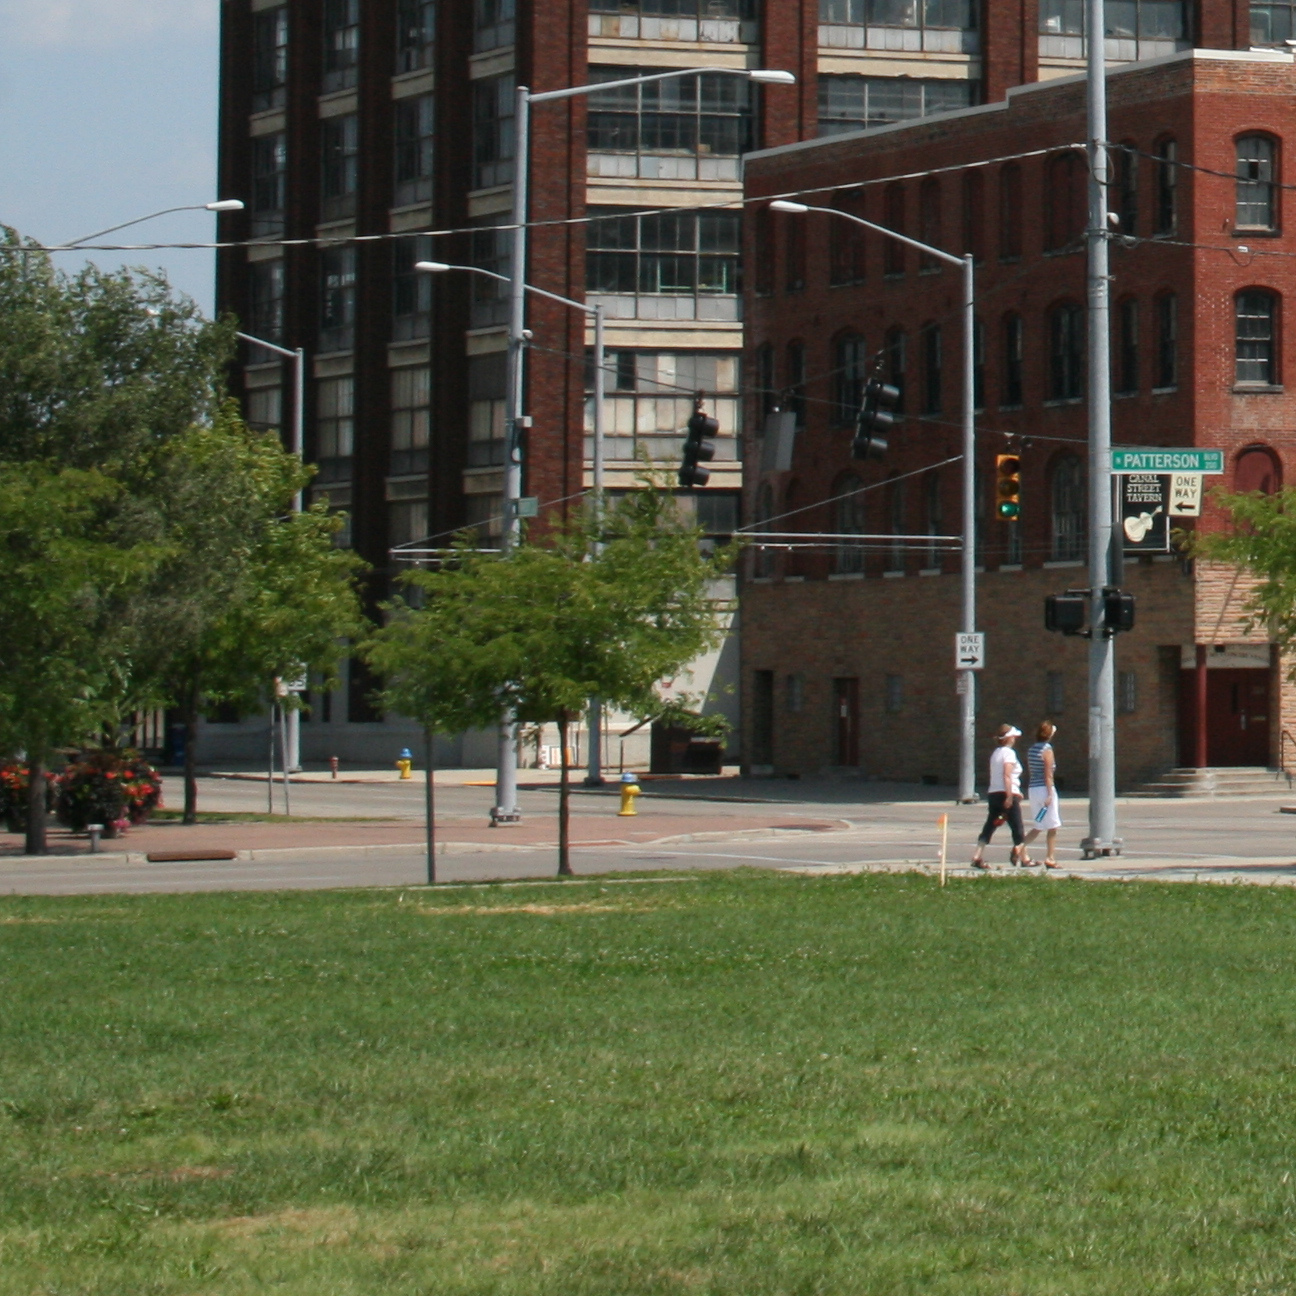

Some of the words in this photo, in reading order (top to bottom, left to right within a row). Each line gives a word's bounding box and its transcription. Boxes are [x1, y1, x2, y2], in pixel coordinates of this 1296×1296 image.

[1123, 453, 1199, 468] PATTERSON
[1128, 474, 1160, 483] CANAL
[1176, 476, 1197, 487] ONE
[1126, 483, 1162, 493] STREET
[1126, 493, 1163, 502] TAVERN
[1175, 488, 1198, 499] WAY
[960, 635, 980, 644] ONE
[960, 645, 980, 653] WAY
